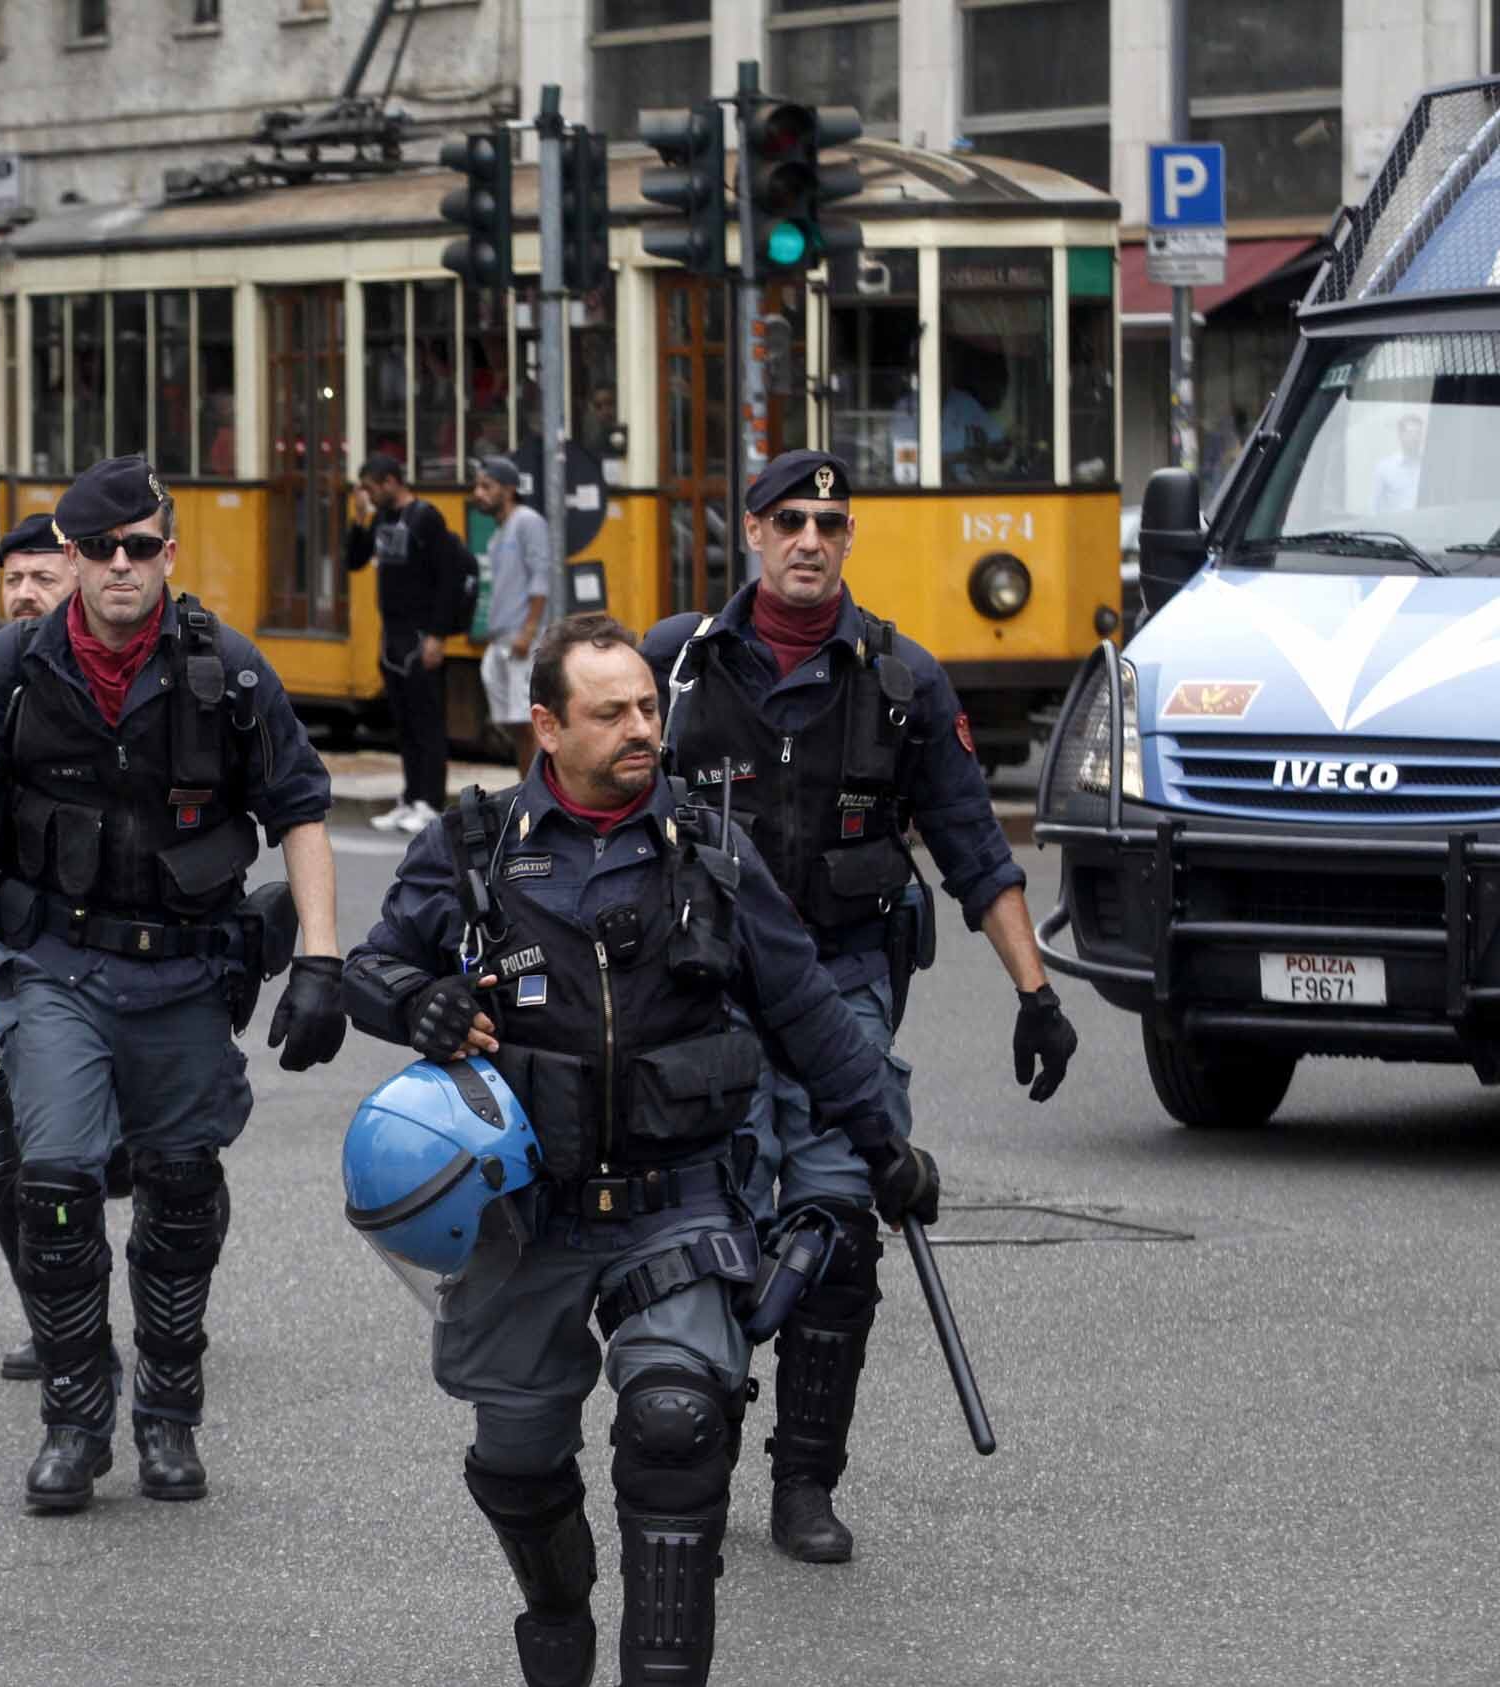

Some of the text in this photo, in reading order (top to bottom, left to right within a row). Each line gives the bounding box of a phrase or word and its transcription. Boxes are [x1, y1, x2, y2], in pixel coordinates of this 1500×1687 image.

[1163, 153, 1208, 219] P
[962, 511, 1034, 542] 1874
[697, 769, 708, 784] A
[1272, 759, 1399, 792] IVECO
[500, 945, 546, 976] POLIZIA
[1285, 954, 1357, 975] POLIZIA
[1290, 975, 1355, 1001] F9671
